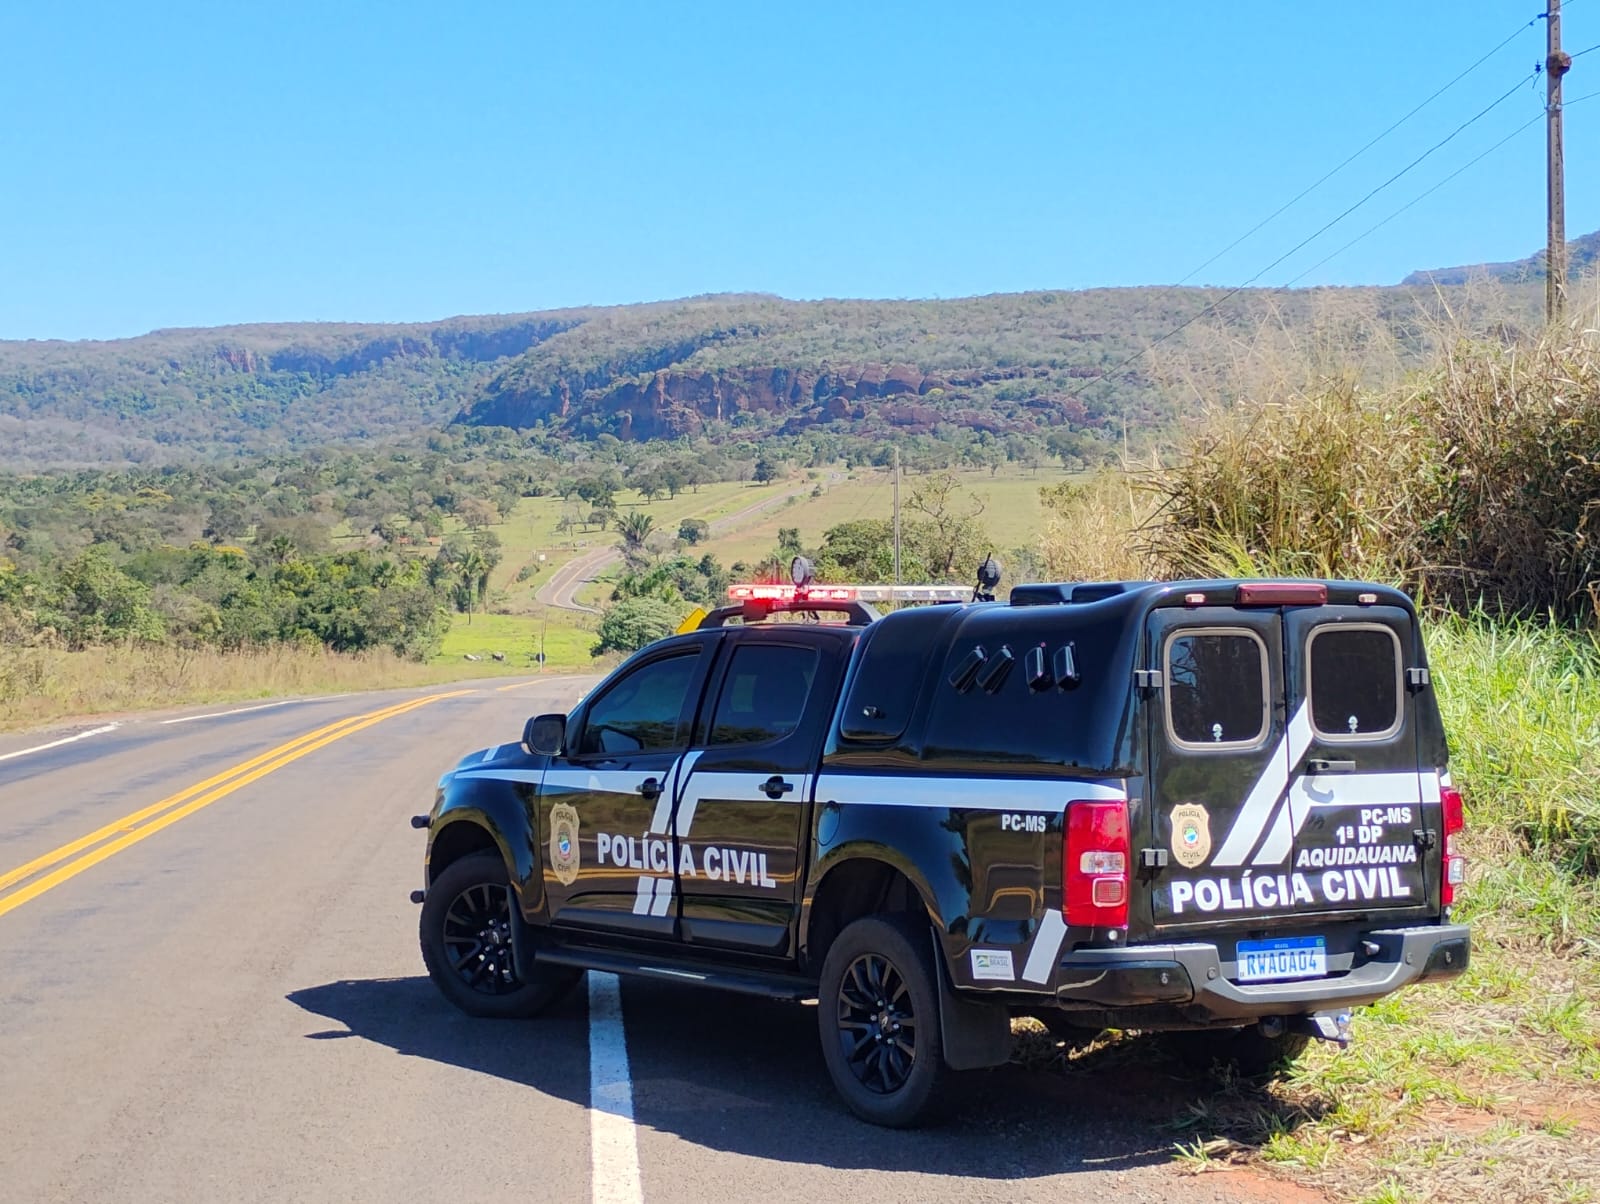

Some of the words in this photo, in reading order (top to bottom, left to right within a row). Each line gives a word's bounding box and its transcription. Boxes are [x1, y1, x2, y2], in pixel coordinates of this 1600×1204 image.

[1001, 813, 1047, 832] PC-MS
[1360, 807, 1412, 825] PC-MS
[1358, 825, 1383, 844] DP
[597, 831, 697, 877] POLÍCIA
[703, 846, 777, 889] CIVIL
[1296, 845, 1417, 867] AQUIDAUANA
[1170, 869, 1314, 914] POLÍCIA
[1321, 866, 1410, 902] CIVIL
